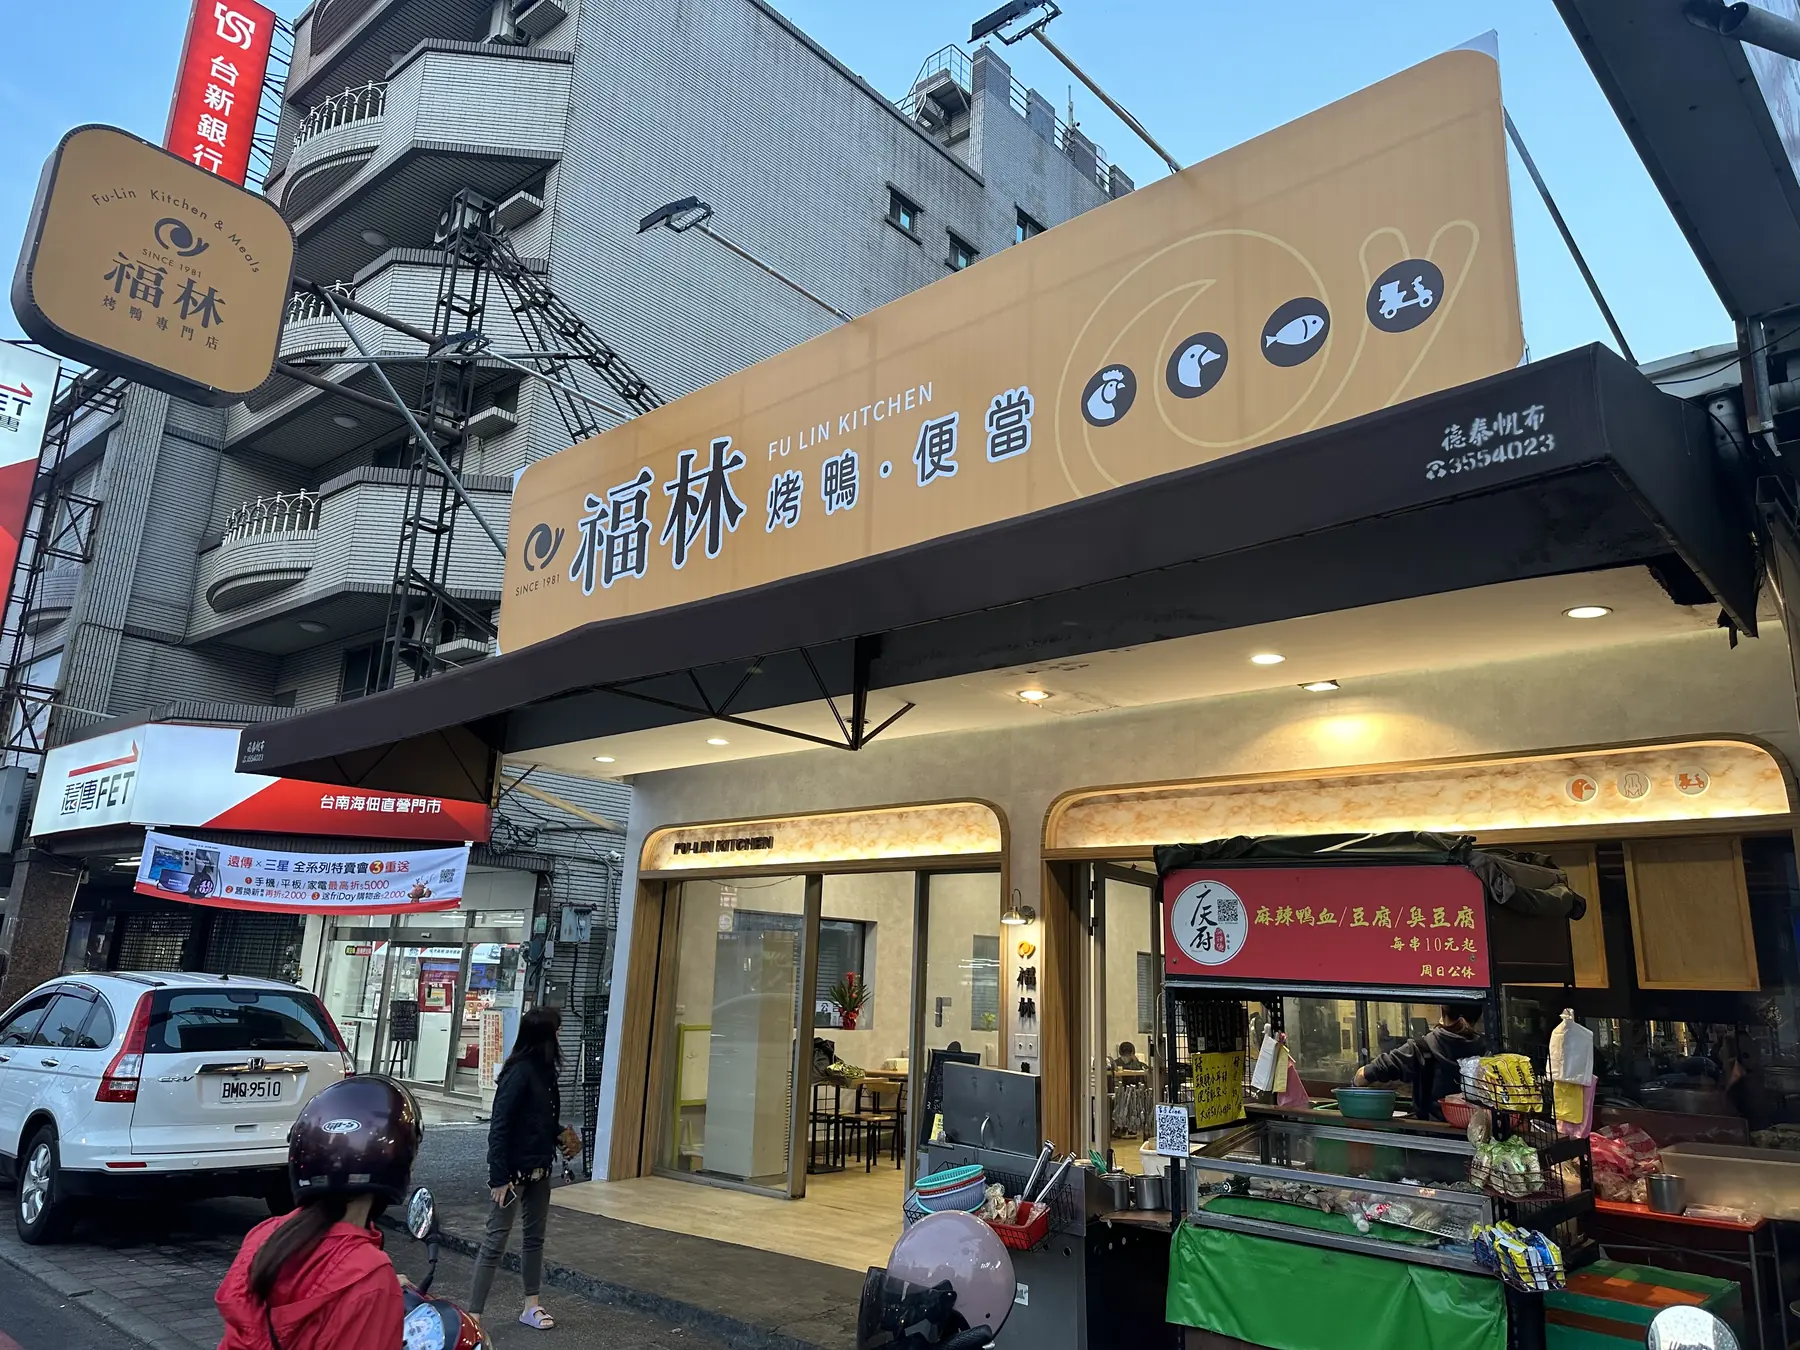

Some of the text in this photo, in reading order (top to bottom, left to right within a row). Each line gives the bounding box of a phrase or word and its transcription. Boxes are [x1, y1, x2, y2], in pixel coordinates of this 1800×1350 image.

[192, 55, 240, 174] 台新銀行
[92, 187, 260, 274] Fu-Lin Kitchen & Meals
[141, 248, 202, 278] SINCE 1981
[103, 251, 226, 329] 福林
[101, 295, 219, 351] 烤鴨專門店
[768, 381, 933, 462] FU LIN KITCHEN
[1441, 404, 1545, 452] 德泰帆布
[1448, 433, 1556, 475] 3554023
[569, 437, 747, 596] 福林
[515, 574, 560, 597] SINCE 1981
[319, 794, 442, 815] 台南海佃直營門市
[673, 836, 774, 855] FU-LIN KITCHEN
[1420, 964, 1475, 979] 周日公休
[222, 1080, 281, 1099] BMQ-9510
